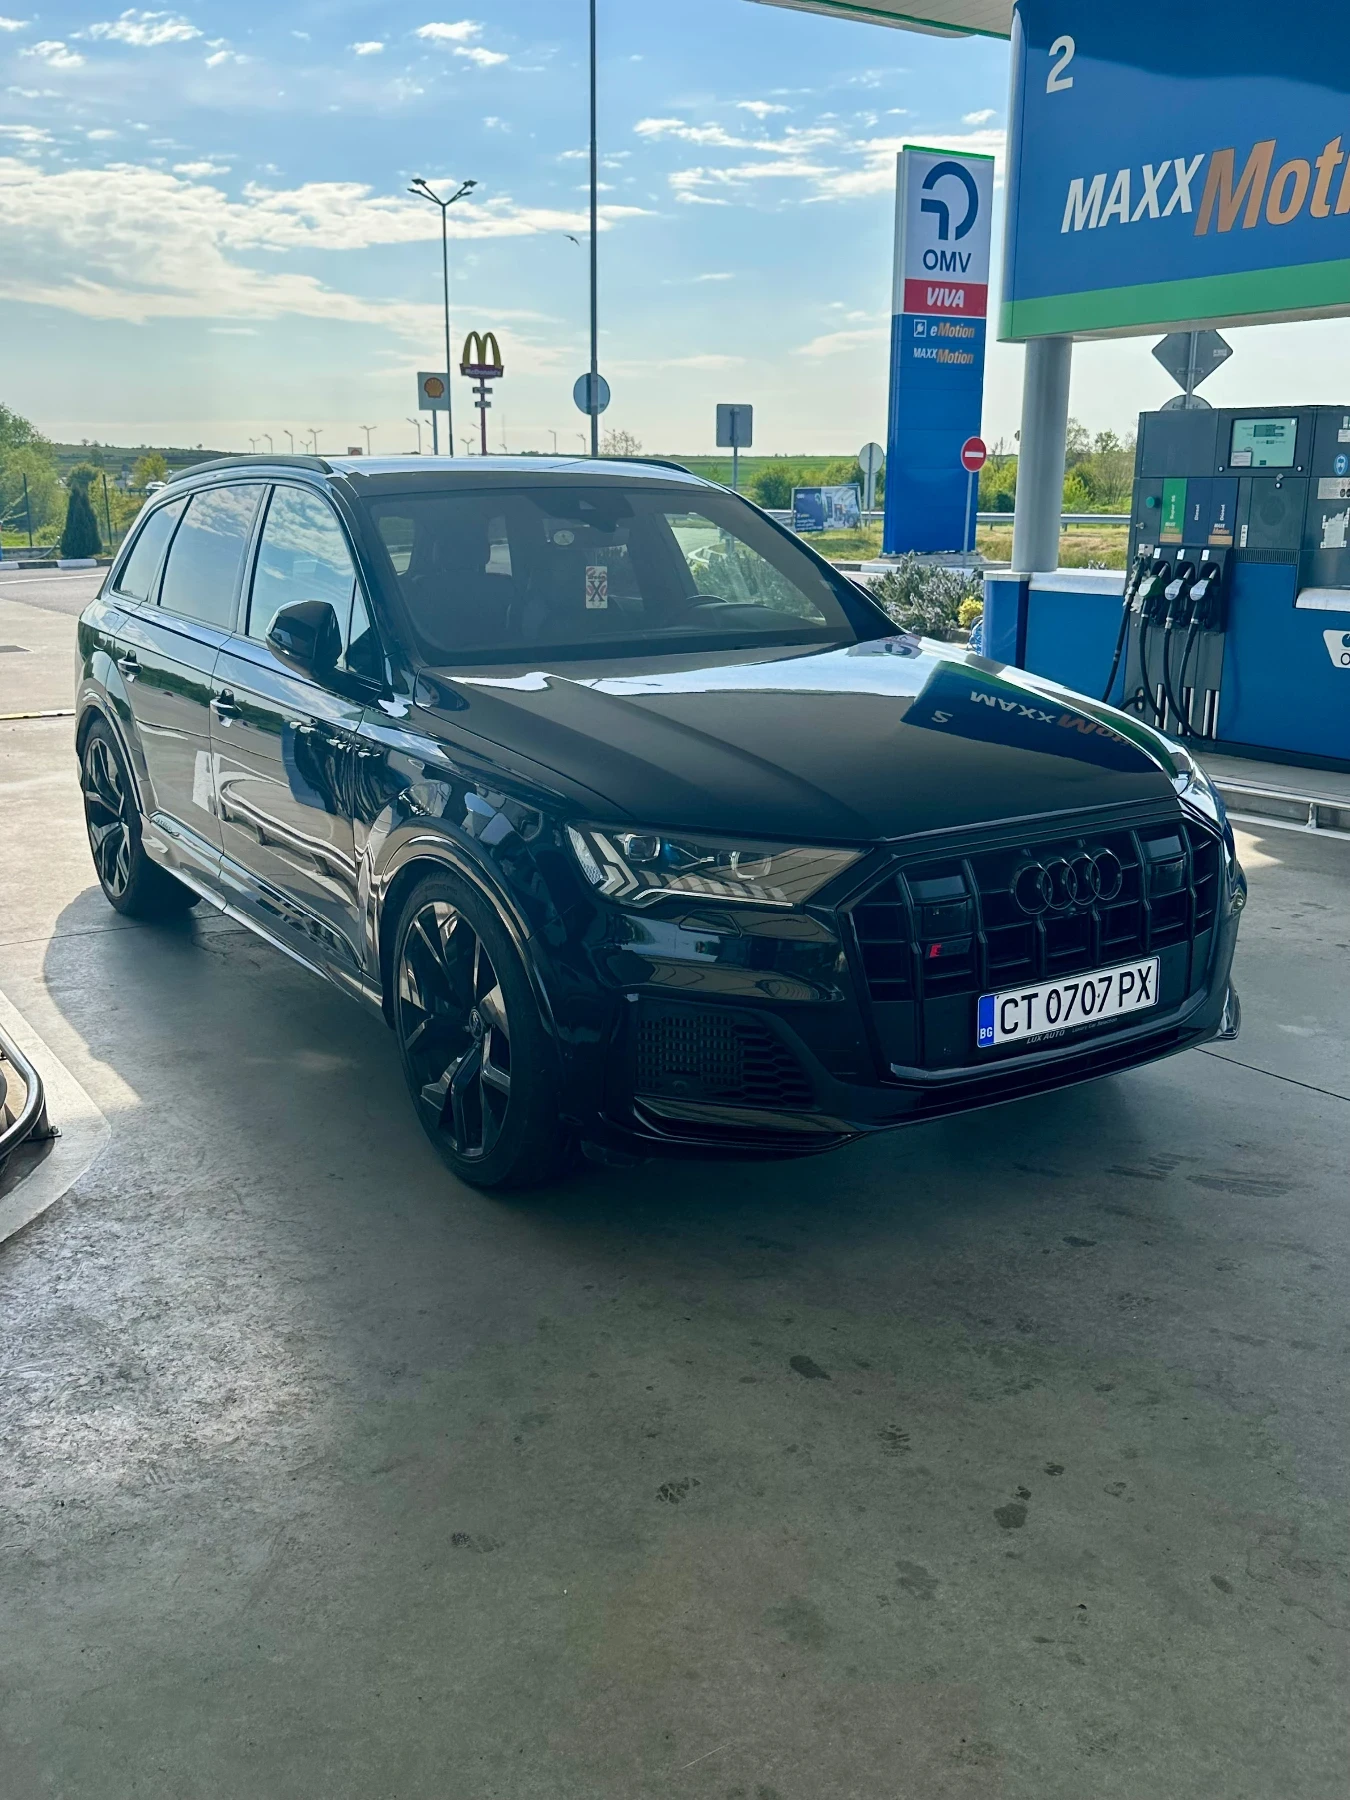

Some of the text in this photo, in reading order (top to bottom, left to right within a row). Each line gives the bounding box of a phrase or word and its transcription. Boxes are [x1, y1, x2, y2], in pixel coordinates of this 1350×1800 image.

[1046, 35, 1076, 94] 2
[922, 248, 972, 273] OMV
[926, 286, 965, 308] VIVA
[1000, 965, 1152, 1035] CT 0707 PX
[980, 1027, 993, 1040] BG
[1026, 1029, 1065, 1044] LUX AUTO
